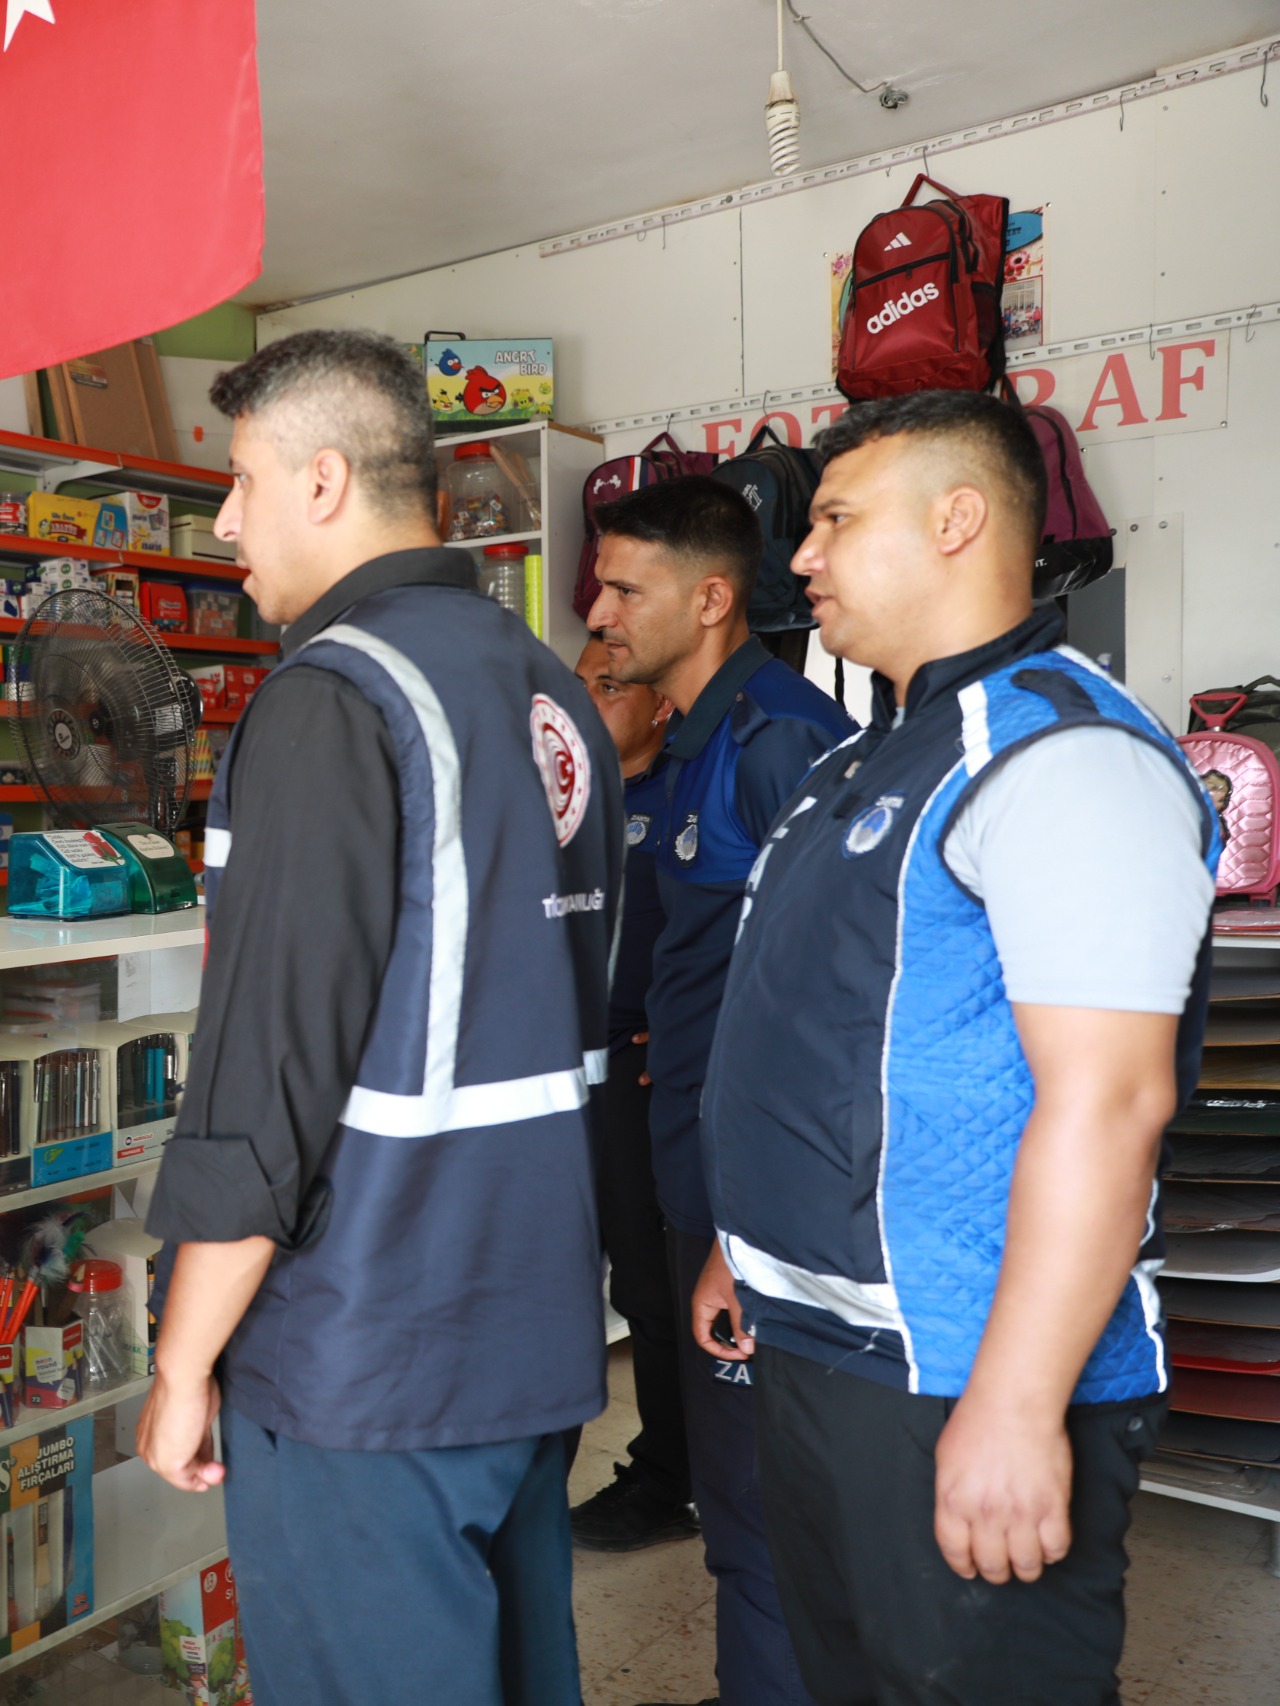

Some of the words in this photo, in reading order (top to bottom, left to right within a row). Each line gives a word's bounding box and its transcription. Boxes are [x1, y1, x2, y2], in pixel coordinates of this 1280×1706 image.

[866, 282, 940, 335] adidas
[520, 363, 547, 376] BIRD
[714, 1360, 752, 1385] ZA
[36, 1436, 74, 1460] JUMBO
[17, 1449, 75, 1480] ALIŞTIRMA
[20, 1460, 75, 1491] FIRÇALARI
